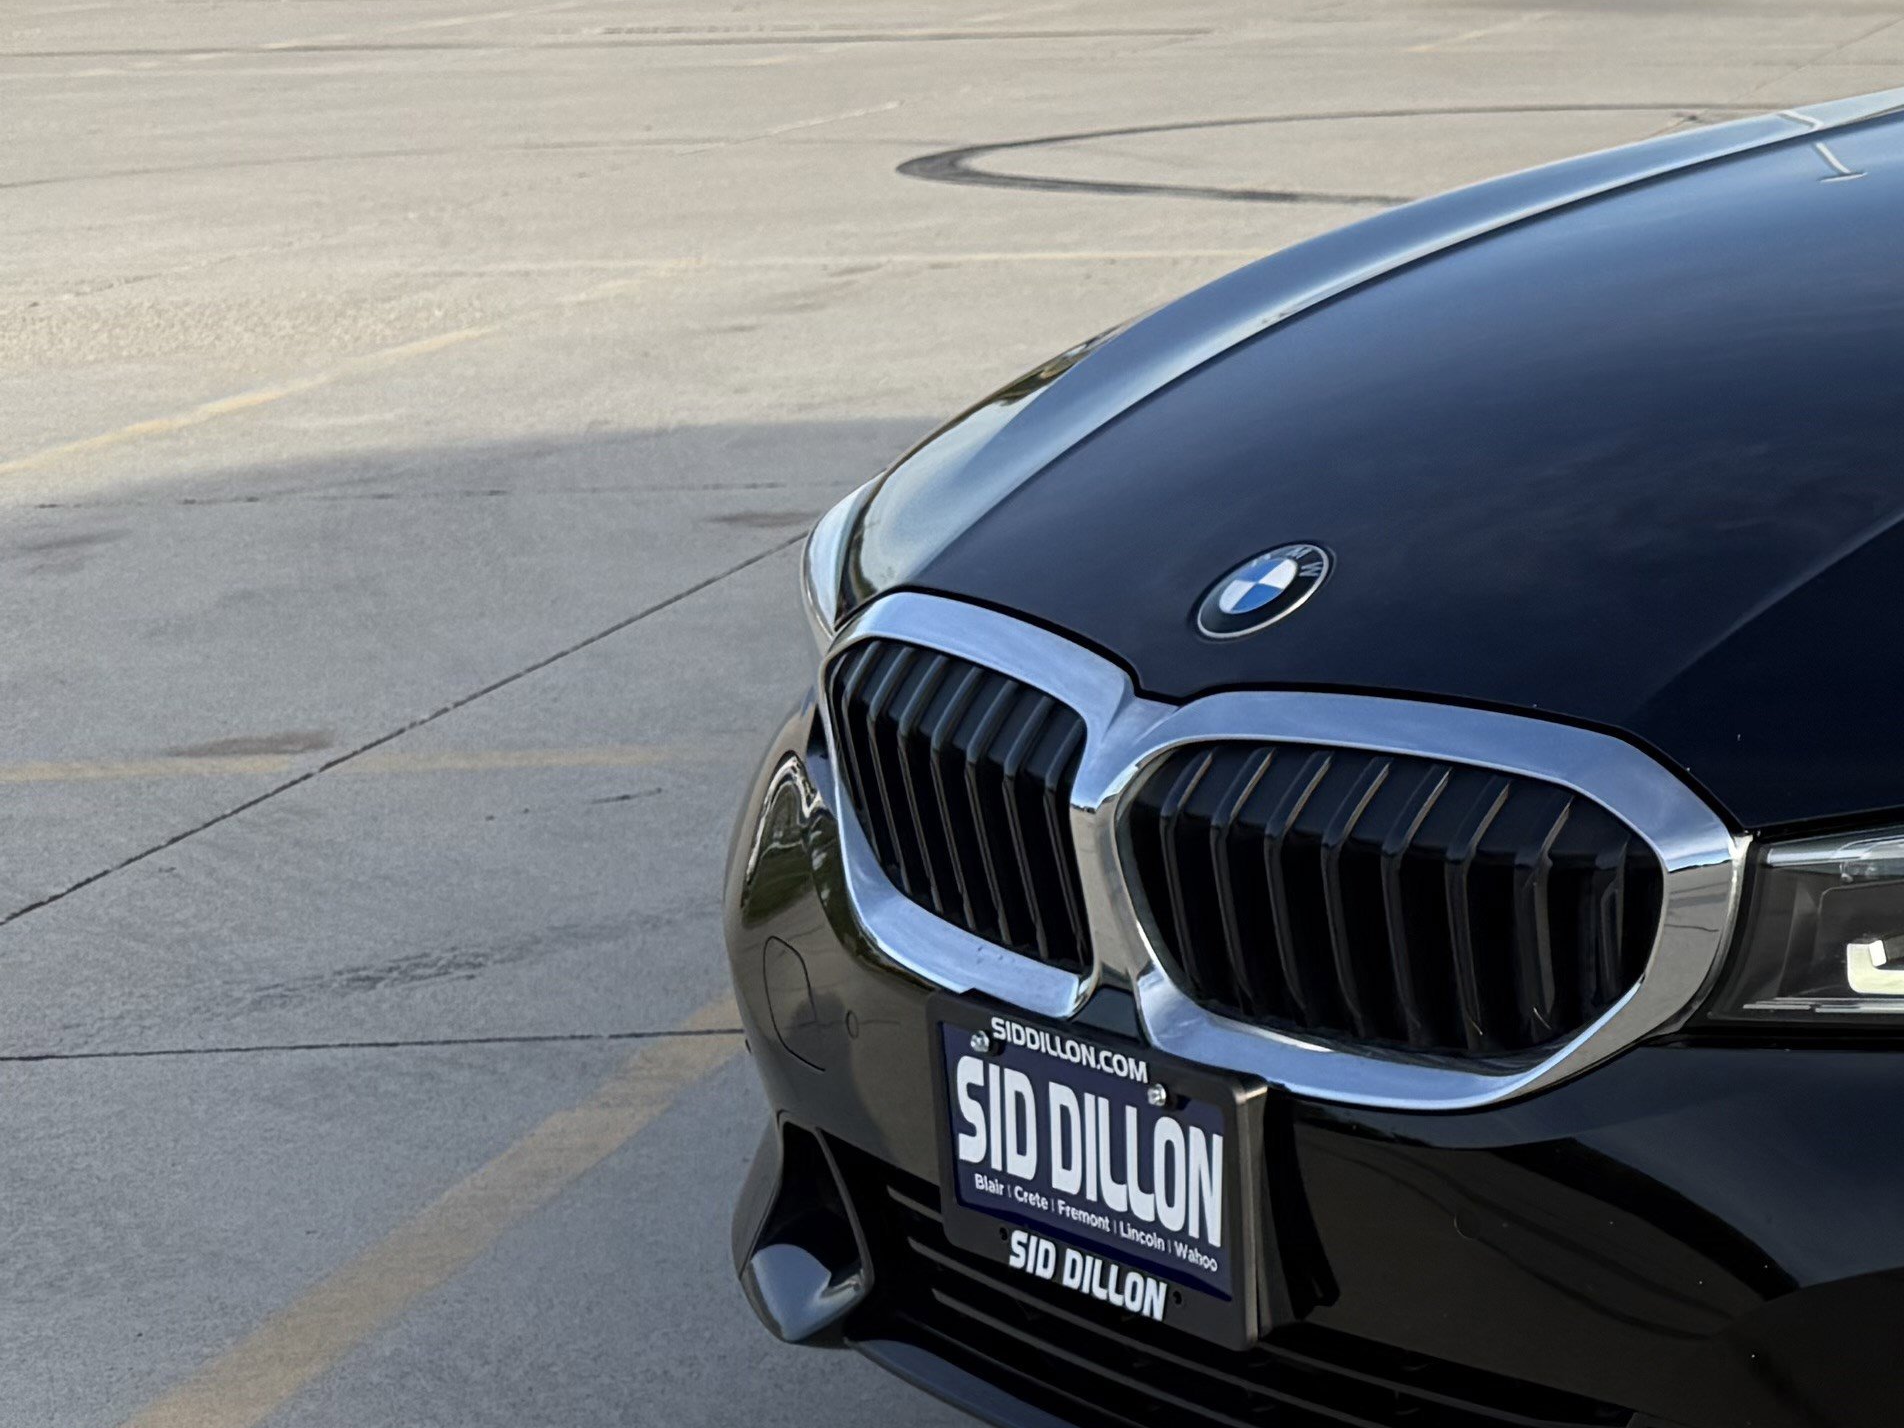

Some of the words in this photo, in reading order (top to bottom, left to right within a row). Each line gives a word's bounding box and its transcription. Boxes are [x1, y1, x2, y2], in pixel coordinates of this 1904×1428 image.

[990, 1016, 1149, 1084] SIDDILLON.COM
[956, 1054, 1038, 1181] SID
[1048, 1079, 1224, 1248] DILLON
[974, 1172, 1004, 1196] Blair
[1014, 1185, 1049, 1211] Crete
[1057, 1199, 1110, 1233] Fremont
[1119, 1220, 1165, 1252] Lincoln
[1174, 1240, 1218, 1272] Wahoo
[1008, 1229, 1057, 1280] SID
[1062, 1248, 1168, 1322] DILLON
